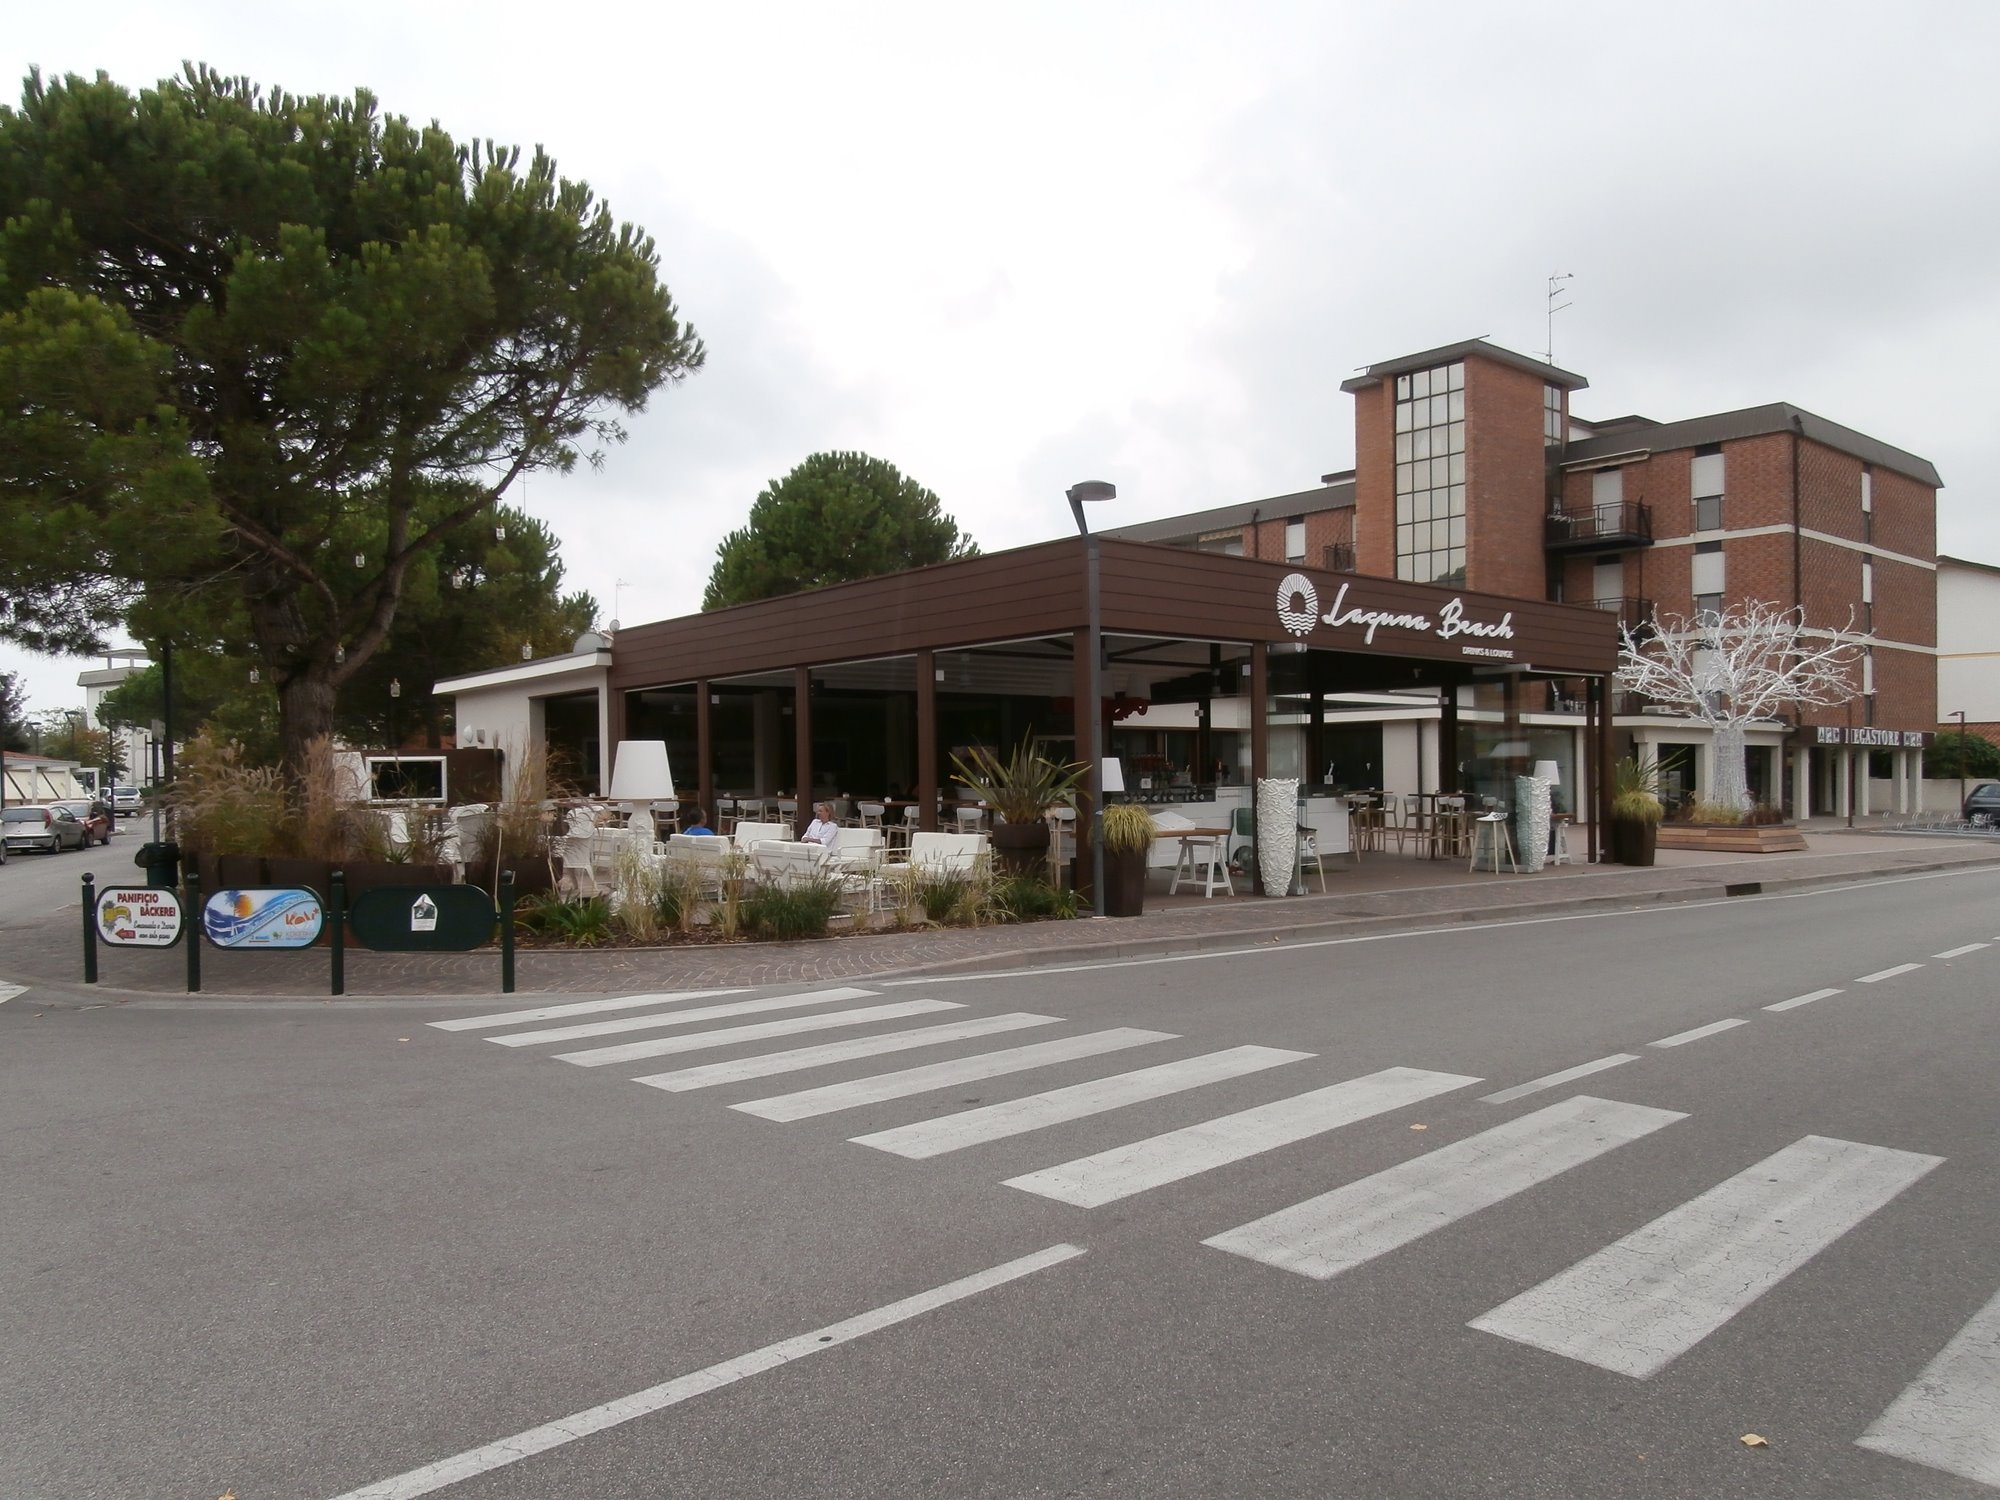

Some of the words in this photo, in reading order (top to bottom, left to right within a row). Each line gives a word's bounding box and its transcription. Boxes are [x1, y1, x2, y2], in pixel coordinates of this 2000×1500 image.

[1321, 582, 1431, 645] Laguna
[1436, 597, 1514, 640] Beach
[1462, 646, 1485, 656] DRINKS
[1490, 649, 1514, 659] LOUNGE
[117, 893, 159, 903] PANIFICIO
